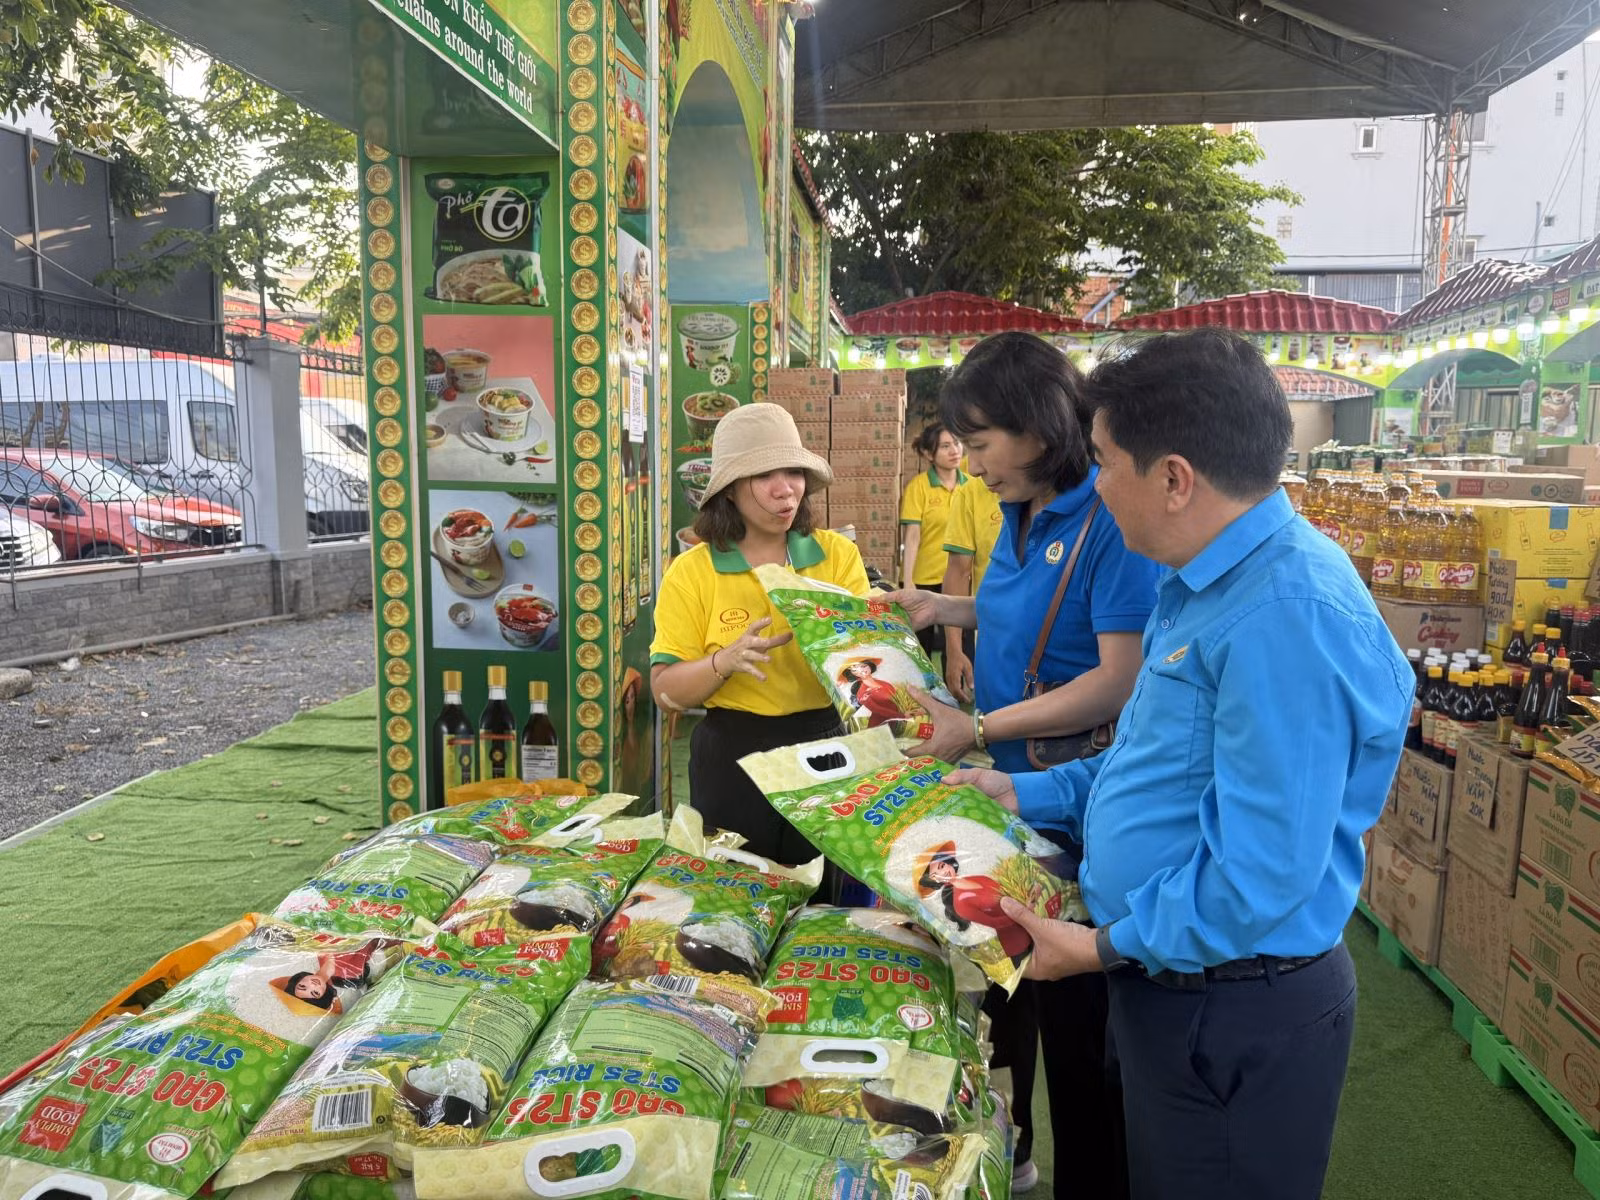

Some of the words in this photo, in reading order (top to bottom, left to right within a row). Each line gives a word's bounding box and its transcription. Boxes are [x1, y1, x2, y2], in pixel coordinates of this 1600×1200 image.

[463, 3, 493, 43] KHẮP
[495, 29, 516, 65] THẾ
[518, 52, 538, 85] GIỚI
[444, 26, 485, 74] around
[487, 57, 504, 90] the
[506, 79, 533, 114] world
[440, 190, 474, 219] Phở
[863, 785, 917, 827] ST25
[791, 945, 847, 960] RICE
[855, 947, 923, 969] ST25
[775, 960, 859, 984] ST25
[772, 991, 804, 1003] FOO
[174, 1034, 245, 1071] ST25
[68, 1055, 158, 1098] ST25
[528, 1063, 595, 1088] RICE
[601, 1065, 681, 1094] ST25
[152, 1069, 227, 1114] GẠO
[40, 1104, 80, 1126] FOOD
[504, 1090, 603, 1126] ST25
[30, 1117, 75, 1138] SIMPLY
